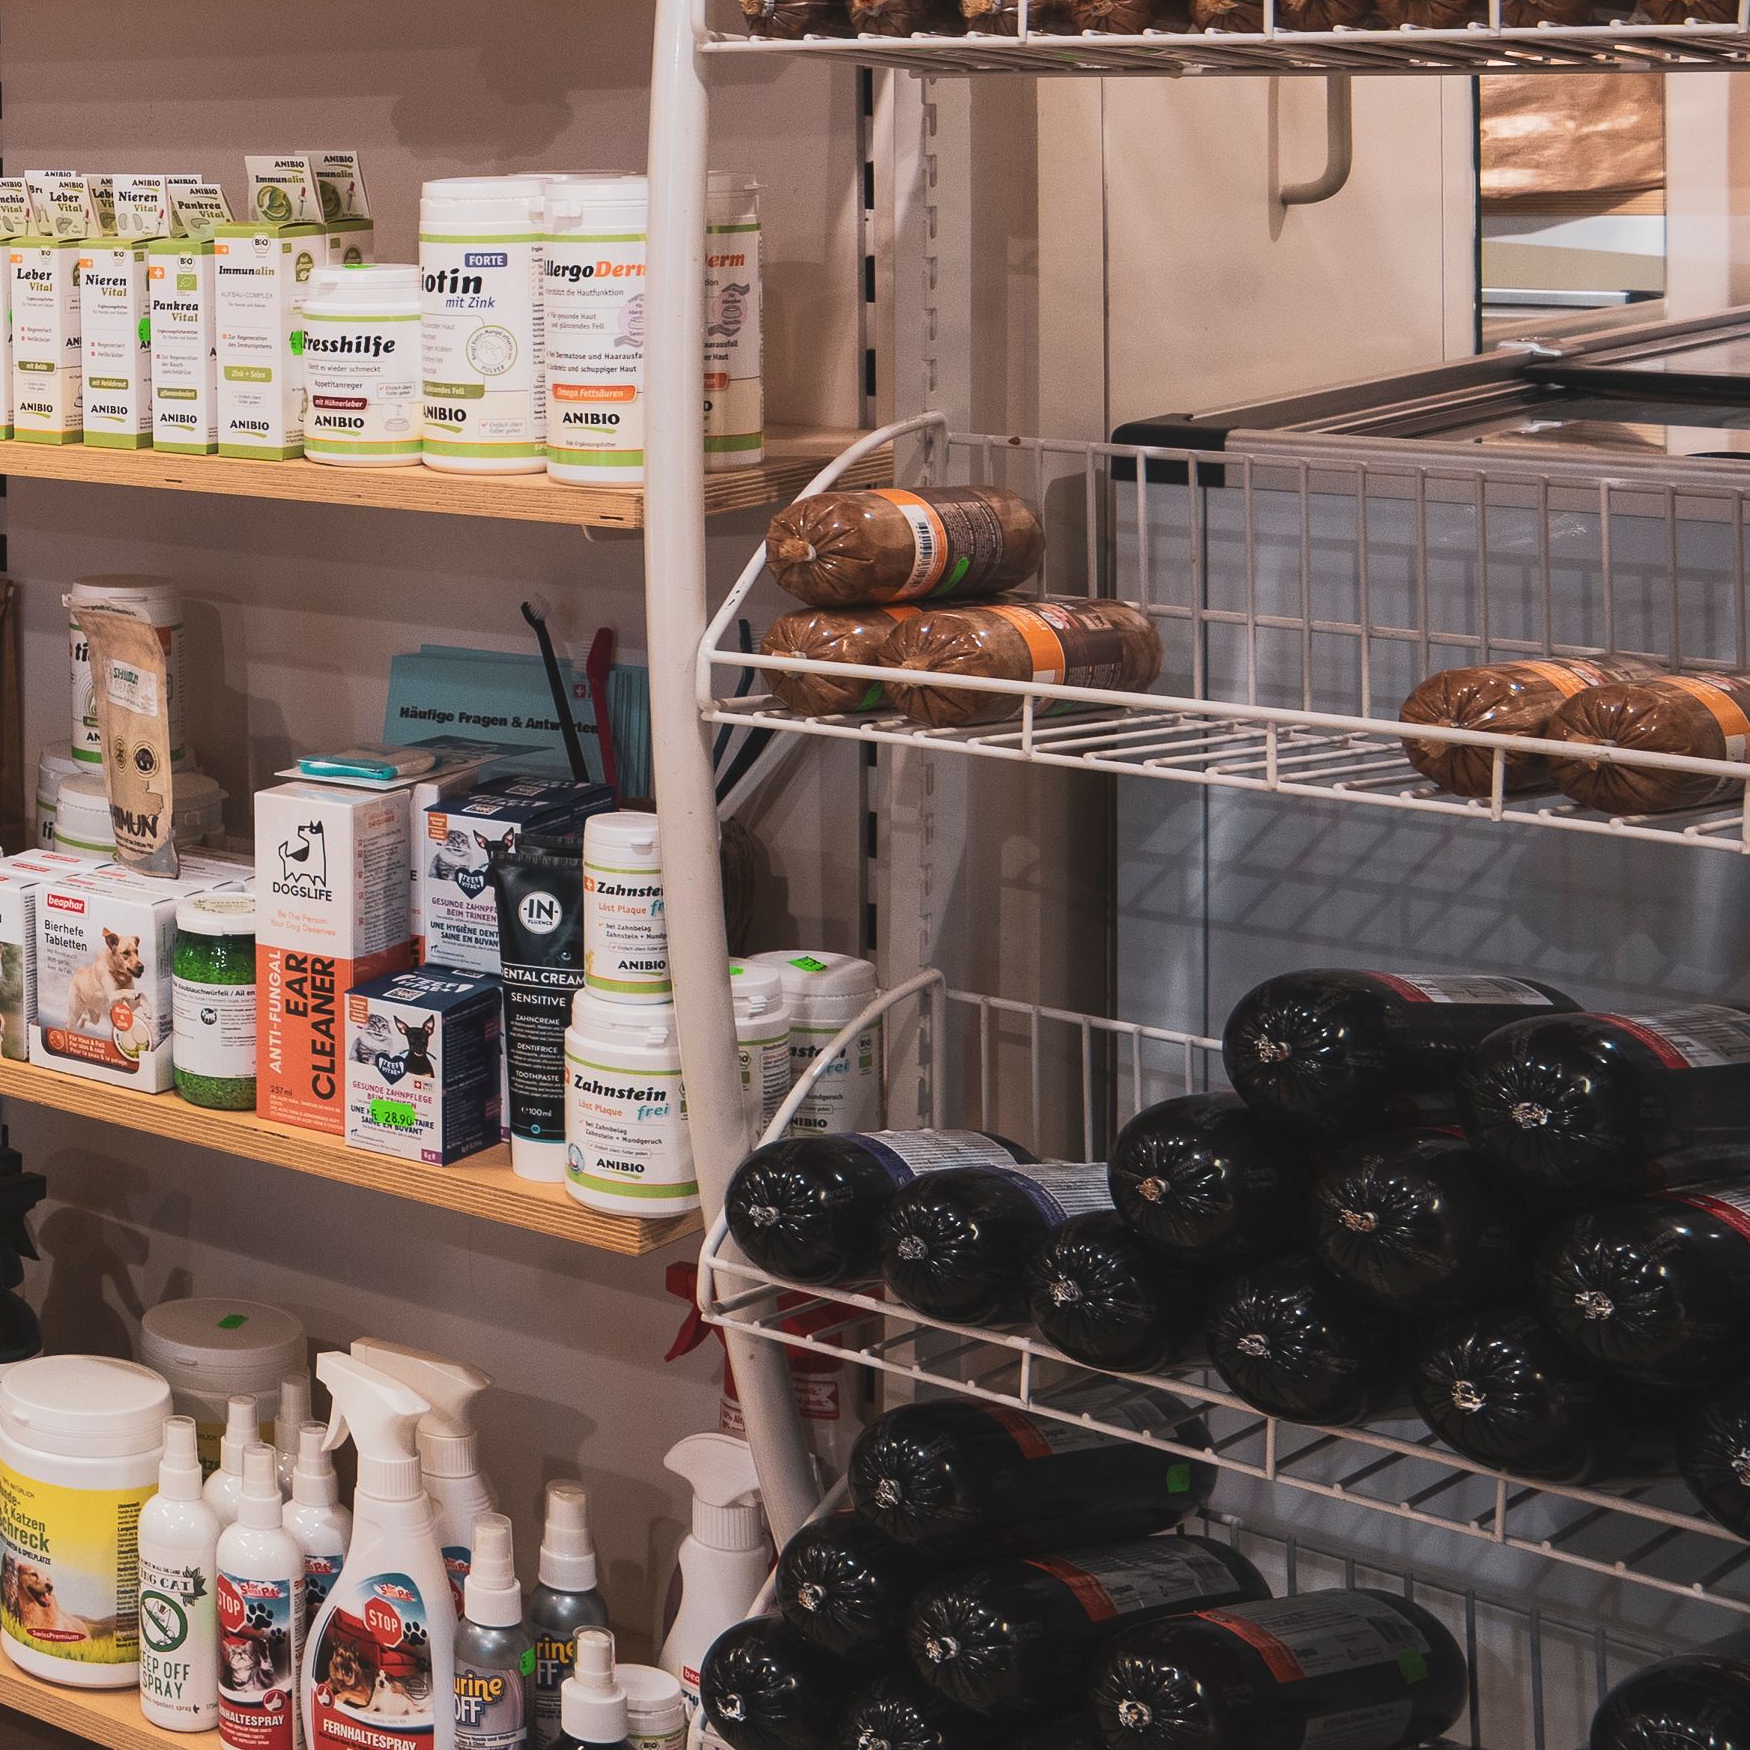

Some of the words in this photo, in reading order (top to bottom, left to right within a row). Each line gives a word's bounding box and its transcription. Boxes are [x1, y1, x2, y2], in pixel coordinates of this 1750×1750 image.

[254, 174, 305, 185] Immunalin
[49, 191, 80, 203] Leber
[118, 190, 158, 203] Nieren
[469, 254, 505, 267] FORTE
[16, 268, 53, 282] Leber
[218, 264, 275, 277] Immunalin
[85, 274, 127, 286] Nieren
[152, 300, 199, 314] Pankrea
[445, 296, 464, 310] mit
[468, 296, 496, 310] Zink
[303, 330, 396, 355] Fresshilfe
[314, 415, 365, 430] ANIBIO
[562, 412, 621, 426] ANIBIO
[400, 706, 455, 724] Häufige
[458, 711, 508, 728] Fragen
[512, 717, 522, 728] &
[525, 717, 599, 735] Antwrten
[272, 881, 333, 903] DOGSLIFE
[47, 895, 84, 913] beaphar
[598, 901, 615, 913] Löst
[44, 919, 84, 938] Bierhefe
[430, 921, 445, 931] UNE
[446, 921, 478, 937] HYGIÈNE
[44, 933, 88, 952] Tabletten
[285, 952, 309, 1019] EAR
[540, 969, 584, 986] CREAM
[511, 992, 566, 1007] SENSITIVE
[268, 950, 283, 1074] ANTI-FUNGAL
[515, 1015, 560, 1025] ZAHNCREME
[311, 958, 337, 1101] CLEANER
[517, 1043, 558, 1054] DENTIFRICE
[516, 1070, 560, 1082] TOOTHPASTE
[352, 1080, 385, 1096] GESUNDE
[386, 1086, 433, 1105] ZAHNPFLEGE
[574, 1074, 667, 1103] Zahnstein
[577, 1099, 593, 1111] Löst
[594, 1104, 623, 1118] Plaque
[637, 1103, 669, 1121] frei
[384, 1111, 413, 1127] 28.90
[596, 1158, 645, 1175] ANIBIO
[10, 1509, 47, 1534] Katzen
[160, 1576, 191, 1592] CAT
[368, 1609, 399, 1633] STOP
[142, 1657, 160, 1675] EEP
[164, 1662, 191, 1680] OFF
[142, 1677, 183, 1700] SPRAY
[322, 1717, 417, 1750] FERNHALTESPRAY
